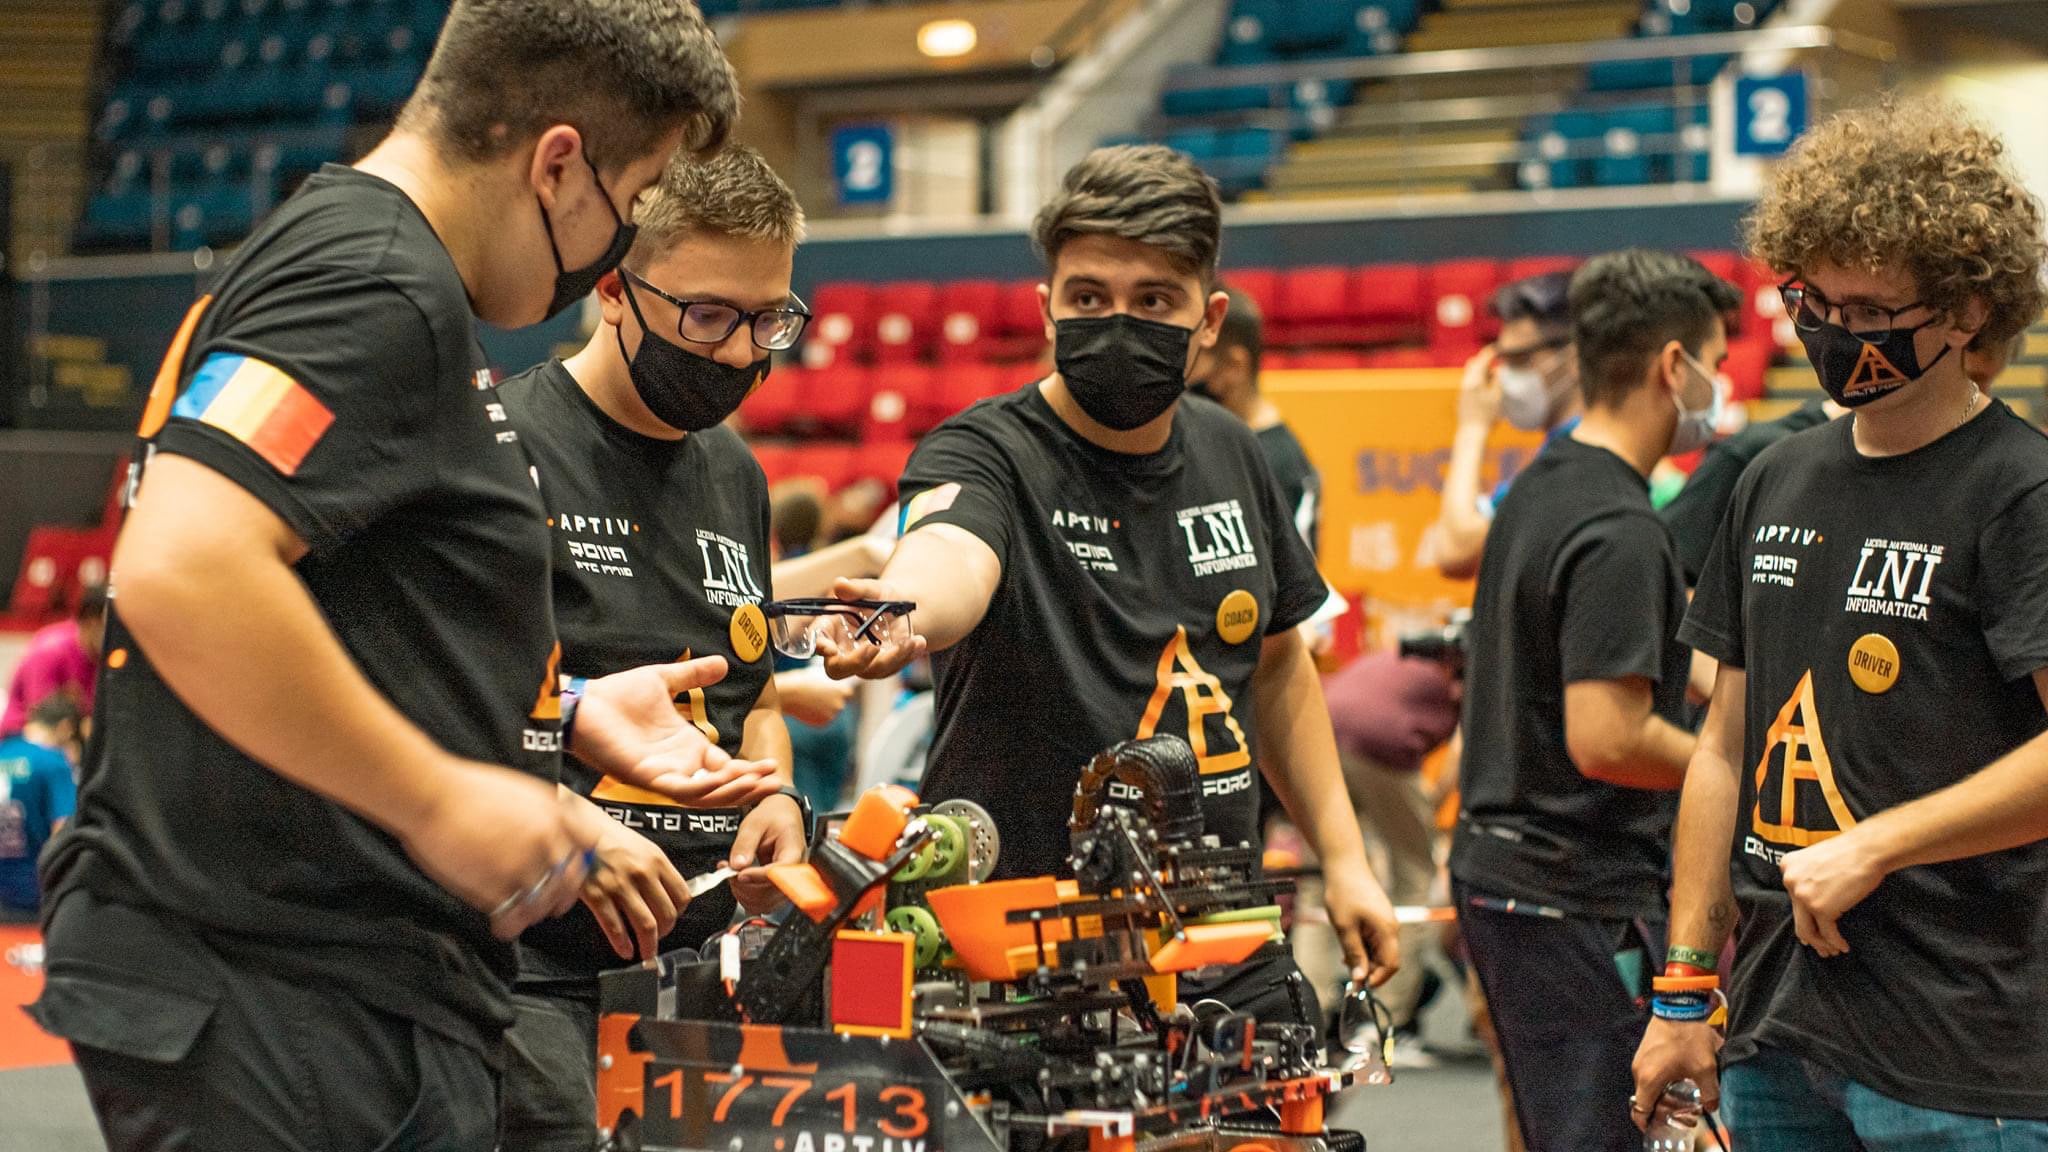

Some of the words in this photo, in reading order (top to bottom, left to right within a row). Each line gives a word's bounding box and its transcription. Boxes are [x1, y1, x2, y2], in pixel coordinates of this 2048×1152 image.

[1748, 88, 1791, 142] 2
[846, 143, 882, 189] 2
[560, 513, 629, 535] APTIV
[1052, 509, 1108, 533] APTIV
[1178, 509, 1254, 563] LNI
[1755, 525, 1816, 545] APTIV
[696, 538, 764, 598] LNI
[1847, 548, 1942, 604] LNI
[1224, 608, 1254, 628] COACH
[1845, 597, 1928, 621] INFORMATICA
[738, 612, 763, 652] DRIVER
[1854, 650, 1892, 678] DRIVER
[604, 806, 681, 832] ELTA
[687, 814, 740, 832] FORC
[654, 1069, 929, 1139] 17713
